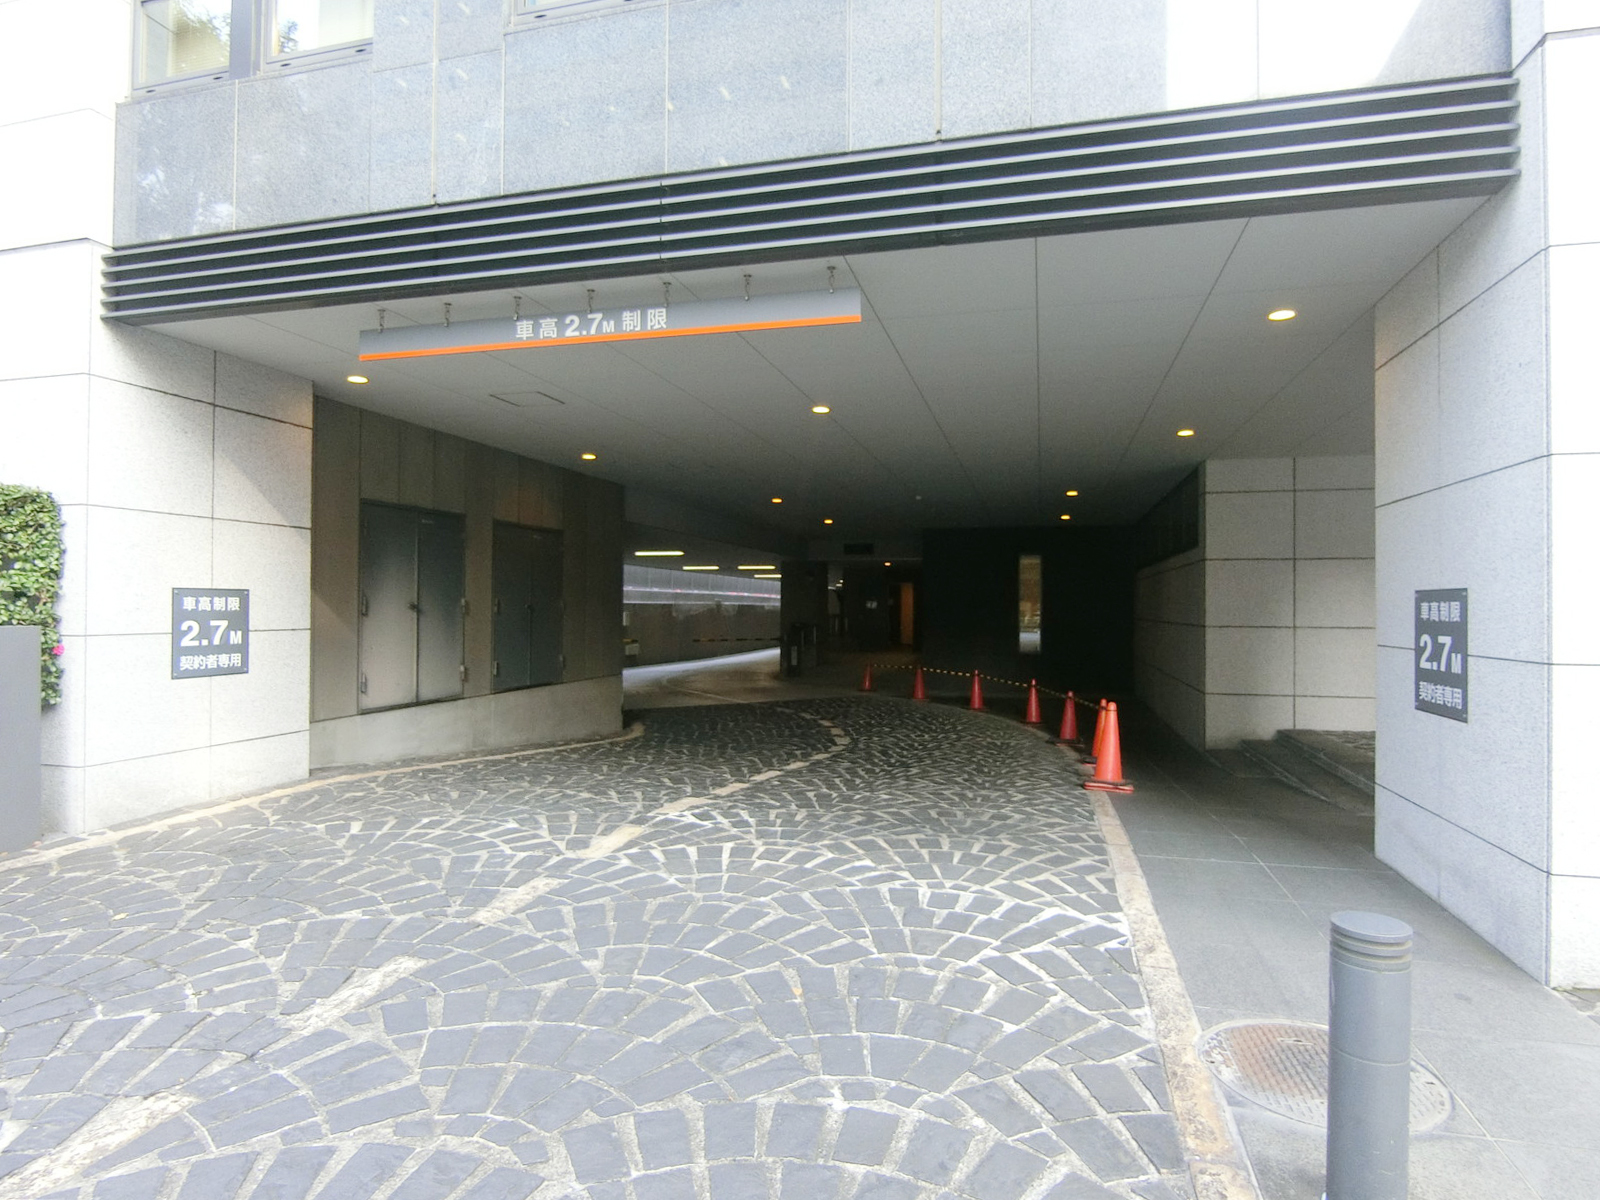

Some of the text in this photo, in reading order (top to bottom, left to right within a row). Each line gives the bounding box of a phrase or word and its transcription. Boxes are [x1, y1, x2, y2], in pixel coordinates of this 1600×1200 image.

[182, 596, 241, 611] 車高制限
[1420, 601, 1461, 622] 車高制限
[180, 652, 242, 671] 契約者専用
[1418, 681, 1462, 710] 契約者専用
